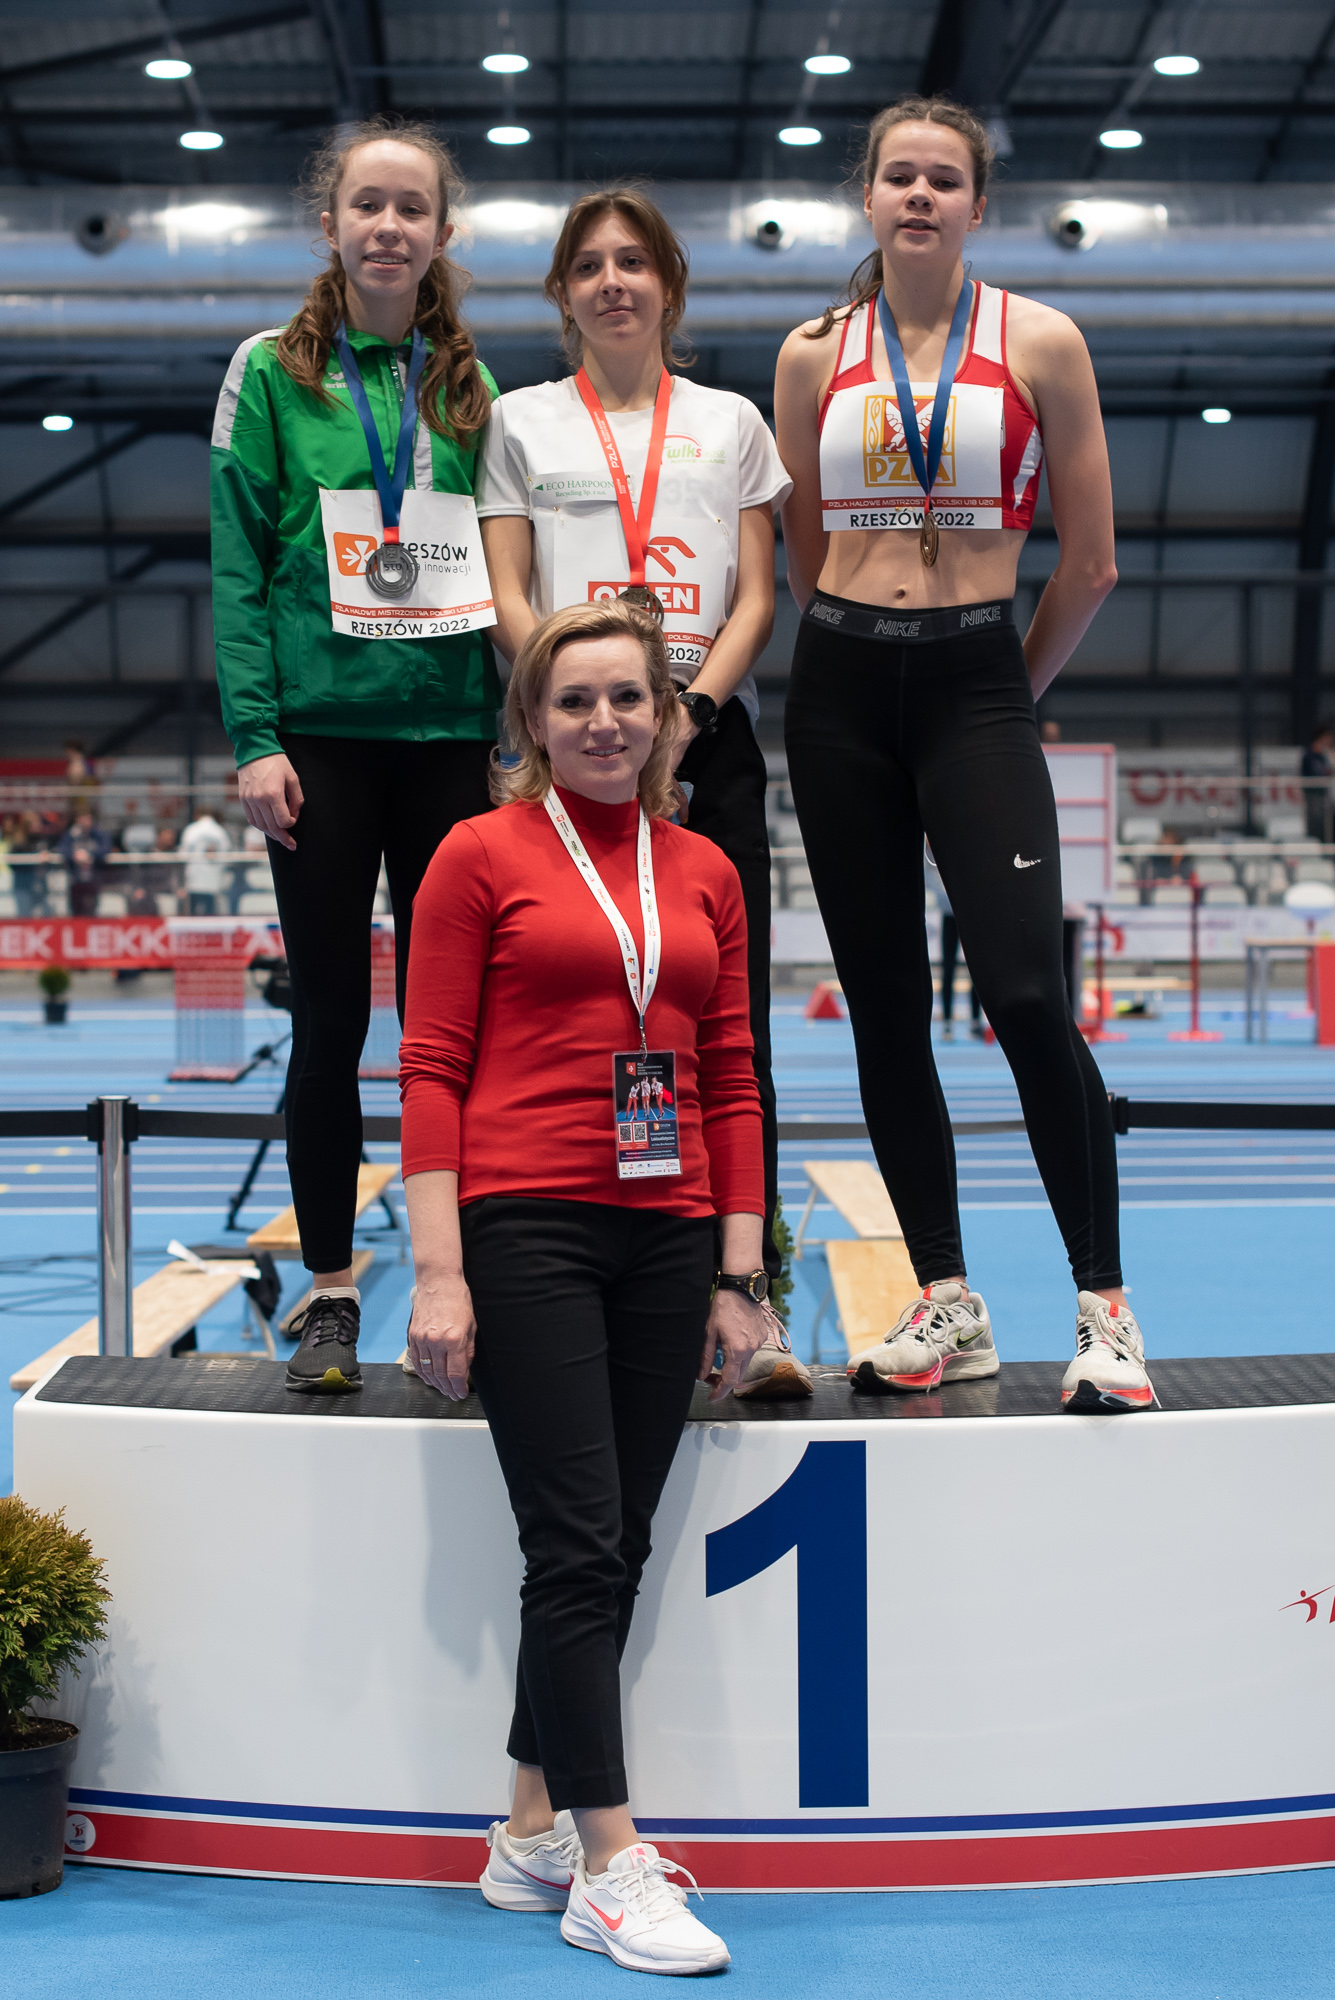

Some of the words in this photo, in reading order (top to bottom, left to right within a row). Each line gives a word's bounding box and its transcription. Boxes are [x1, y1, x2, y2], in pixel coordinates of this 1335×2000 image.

[606, 443, 620, 468] PZLA
[546, 481, 565, 491] ECO
[555, 490, 583, 498] Recycling
[849, 499, 881, 507] HALOWE
[849, 507, 925, 527] RZESZÓW
[935, 512, 975, 526] 2022
[424, 561, 472, 576] innowacji
[350, 607, 376, 616] HALOWE
[377, 609, 429, 617] MISTRZOSTWA
[429, 608, 456, 617] POLSKI
[809, 602, 845, 625] NIKE
[960, 605, 1002, 628] NIKE
[351, 619, 423, 636] RZESZÓW
[429, 618, 471, 634] 2022
[873, 618, 922, 637] NIKE
[667, 634, 694, 642] POLSKI
[668, 647, 702, 664] 2022
[705, 1440, 869, 1809] 1
